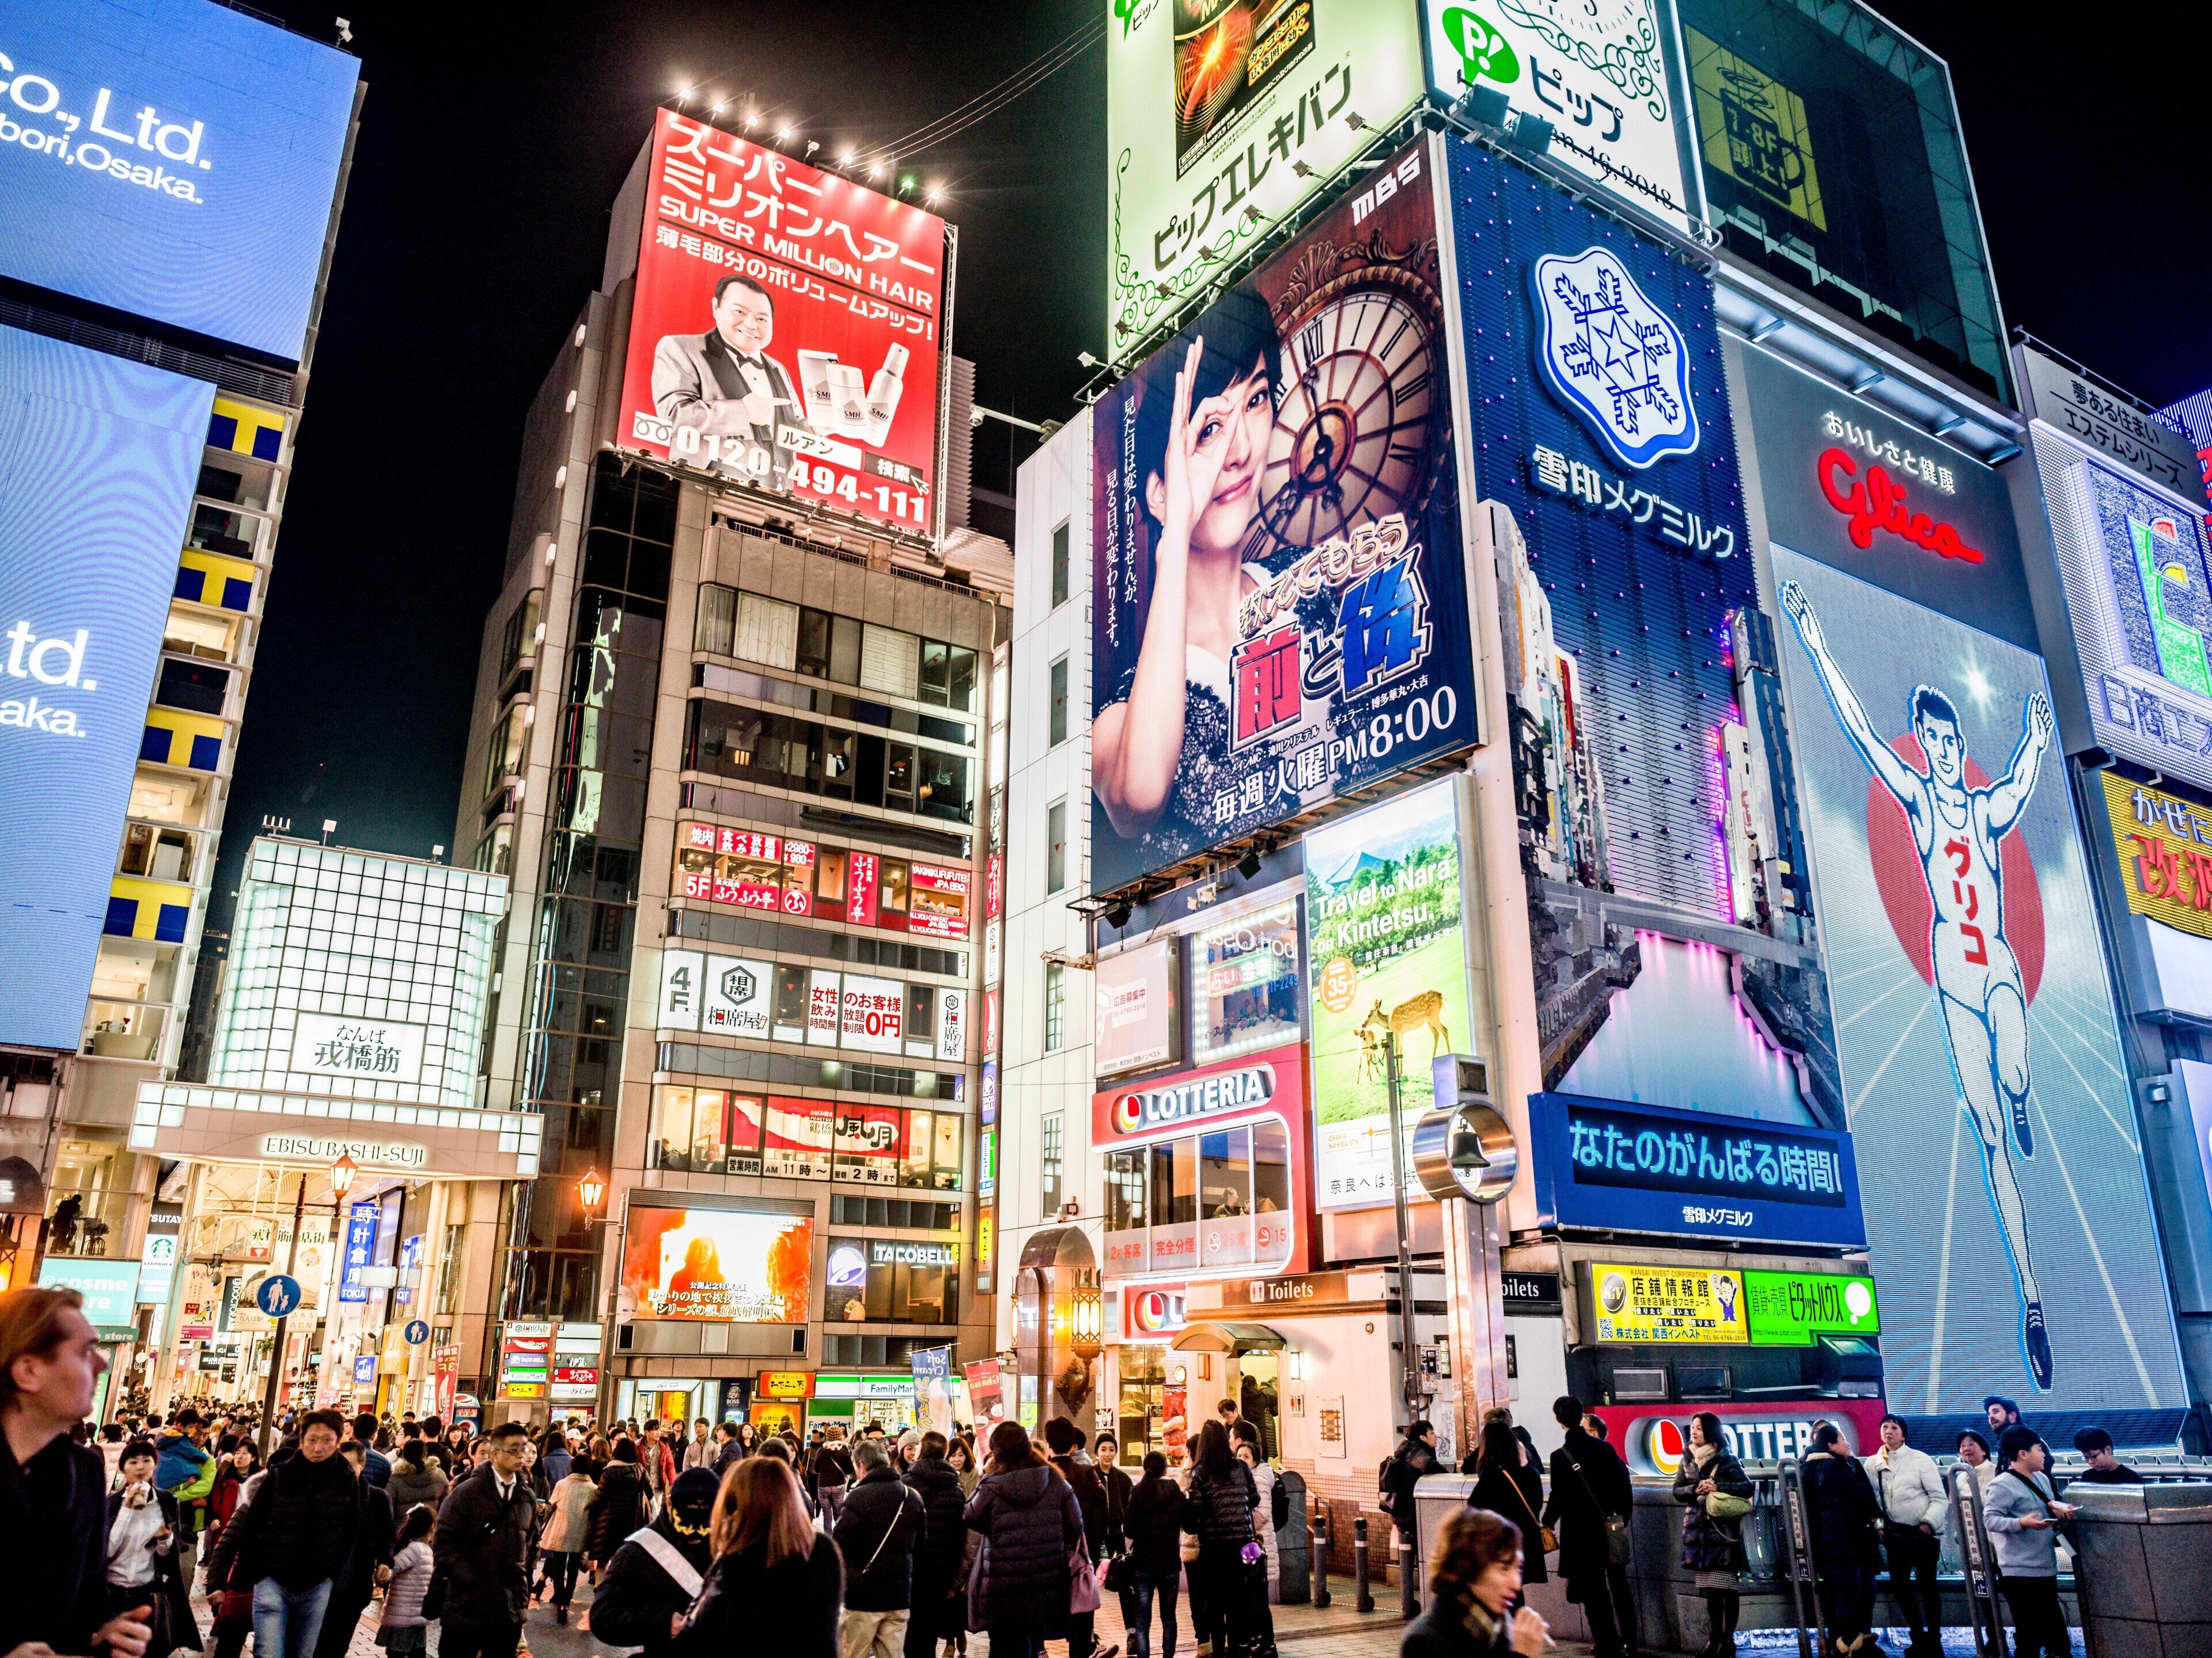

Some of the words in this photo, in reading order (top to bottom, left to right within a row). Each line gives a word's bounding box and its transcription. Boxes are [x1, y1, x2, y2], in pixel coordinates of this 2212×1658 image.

[1249, 3, 1310, 65] ガンコなコリに。
[1530, 54, 1624, 143] ピップ
[666, 122, 823, 197] スーパー
[1154, 63, 1351, 271] ピップエレキバン
[1352, 149, 1421, 226] MBS
[663, 157, 935, 275] ミリオンヘアー
[659, 195, 756, 245] SUPER
[763, 232, 862, 285] MILLION
[870, 272, 933, 312] HAIR
[656, 225, 933, 341] 薄毛部分のボリュームアップ!
[844, 410, 861, 418] SMH
[872, 407, 889, 421] SMH
[2071, 380, 2160, 444] 夢ある住まい
[783, 431, 834, 455] ルアン
[1822, 411, 1956, 495] おいしさと健康
[2064, 408, 2183, 490] エステムシリーズ
[676, 425, 925, 523] 0120-494-111
[877, 459, 911, 483] 検索
[1123, 395, 1138, 604] 見た目は変わりませんが、
[1533, 444, 1734, 558] 雪印メグミルク
[1818, 448, 1983, 564] Glico
[1106, 468, 1119, 648] 見る目が変わります。
[1238, 517, 1407, 637] 教えてもらう
[2132, 787, 2212, 845] かぜに
[691, 827, 714, 846] 焼肉
[721, 842, 776, 860] 飲み放題
[722, 830, 776, 850] 食べ放題
[686, 876, 710, 896] 5F
[715, 887, 775, 910] ふうふう亭
[850, 856, 867, 922] ふうふう亭
[1315, 877, 1385, 921] Travel
[1380, 882, 1396, 899] to
[1397, 858, 1451, 892] Nara
[1944, 835, 1988, 967] グリコ
[1317, 940, 1334, 954] on
[1338, 901, 1434, 947] Kintetsu.
[1113, 988, 1146, 1007] 広告募集中
[1328, 974, 1348, 997] 35
[338, 1024, 386, 1043] なんば
[707, 1006, 762, 1030] 相席屋
[865, 1012, 901, 1038] 0円
[944, 1012, 960, 1057] 相席屋
[314, 1041, 402, 1074] 戎橋筋
[1146, 1070, 1265, 1122] LOTTERIA
[810, 1122, 831, 1135] 鶴橋
[835, 1114, 892, 1151] 風月
[728, 1159, 759, 1174] 営業時間
[1682, 1205, 1753, 1227] 雪印メグミルク
[1156, 1238, 1195, 1257] 完全分煙
[1268, 1281, 1313, 1299] Toilets
[1502, 1279, 1539, 1297] oilets
[1631, 1269, 1650, 1277] KANSAI
[1672, 1270, 1707, 1279] CORPORATION
[1633, 1277, 1709, 1298] 店舗情報館
[342, 1289, 365, 1299] TOKIA
[1751, 1285, 1788, 1316] 賃貸・売買
[1788, 1281, 1844, 1322] ピタットハウス
[104, 1332, 134, 1341] store
[1616, 1328, 1649, 1339] 株式会社
[1652, 1328, 1700, 1339] 関西インベスト
[512, 1373, 543, 1381] FamilyMart
[870, 1384, 914, 1395] FamilyMar
[1722, 1420, 1842, 1459] OTTER
[1964, 1502, 1980, 1564] 自転車進入禁止
